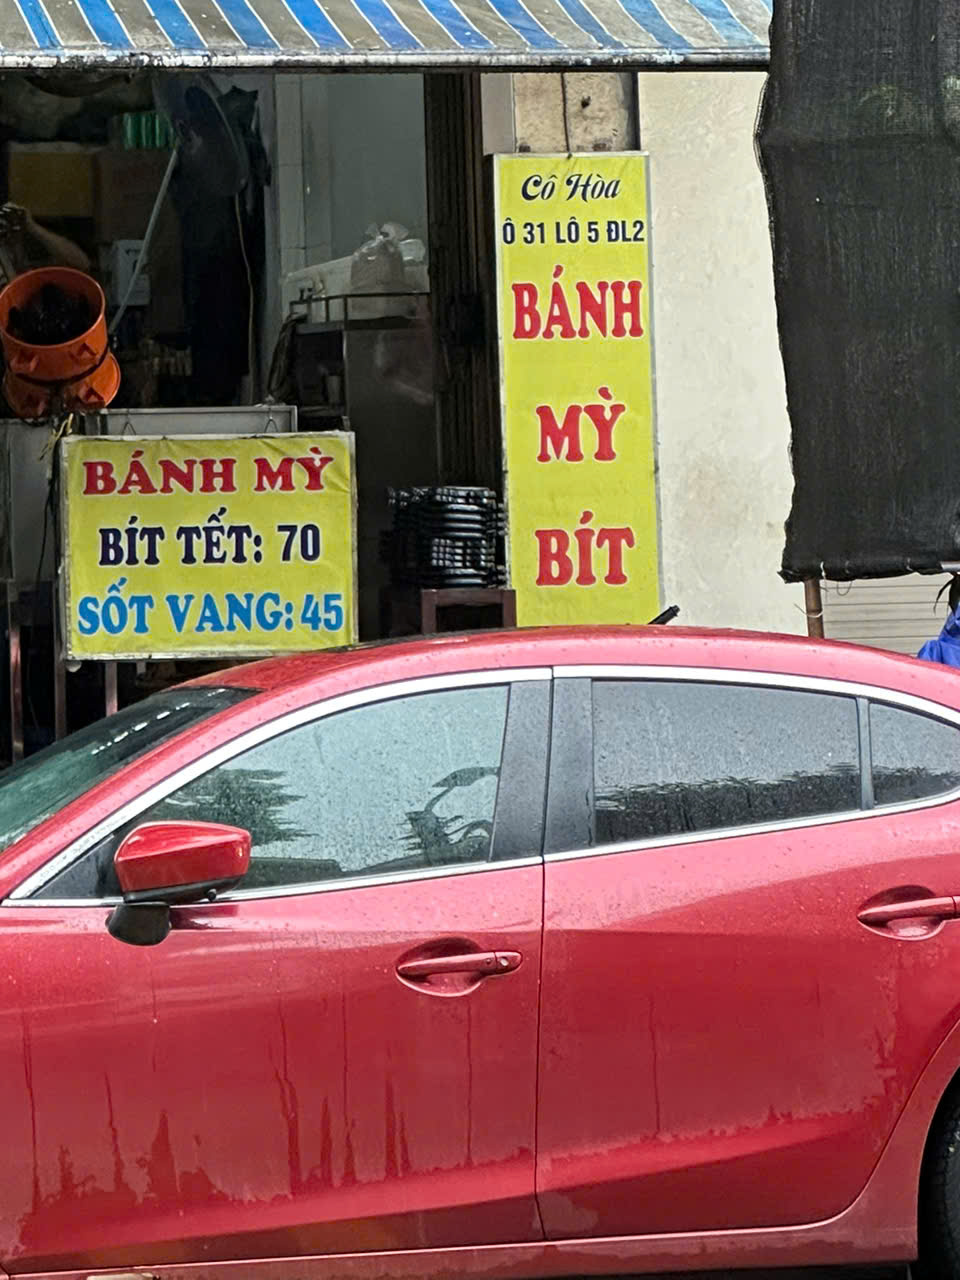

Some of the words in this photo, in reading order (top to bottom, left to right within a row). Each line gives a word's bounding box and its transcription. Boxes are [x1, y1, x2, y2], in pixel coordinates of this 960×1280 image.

[521, 173, 556, 202] Cô
[566, 173, 622, 203] Hòa
[501, 216, 516, 245] Ô
[523, 221, 546, 245] 31
[555, 216, 579, 244] LÔ
[587, 221, 600, 244] 5
[606, 219, 646, 243] ĐL2
[512, 265, 644, 340] BÁNH
[535, 386, 626, 463] MỲ
[82, 449, 238, 495] BÁNH
[253, 446, 335, 493] MỲ
[98, 515, 166, 566] BÍT
[176, 506, 263, 565] TẾT:
[277, 523, 321, 562] 70
[535, 510, 635, 587] BÍT
[77, 576, 155, 635] SỐT
